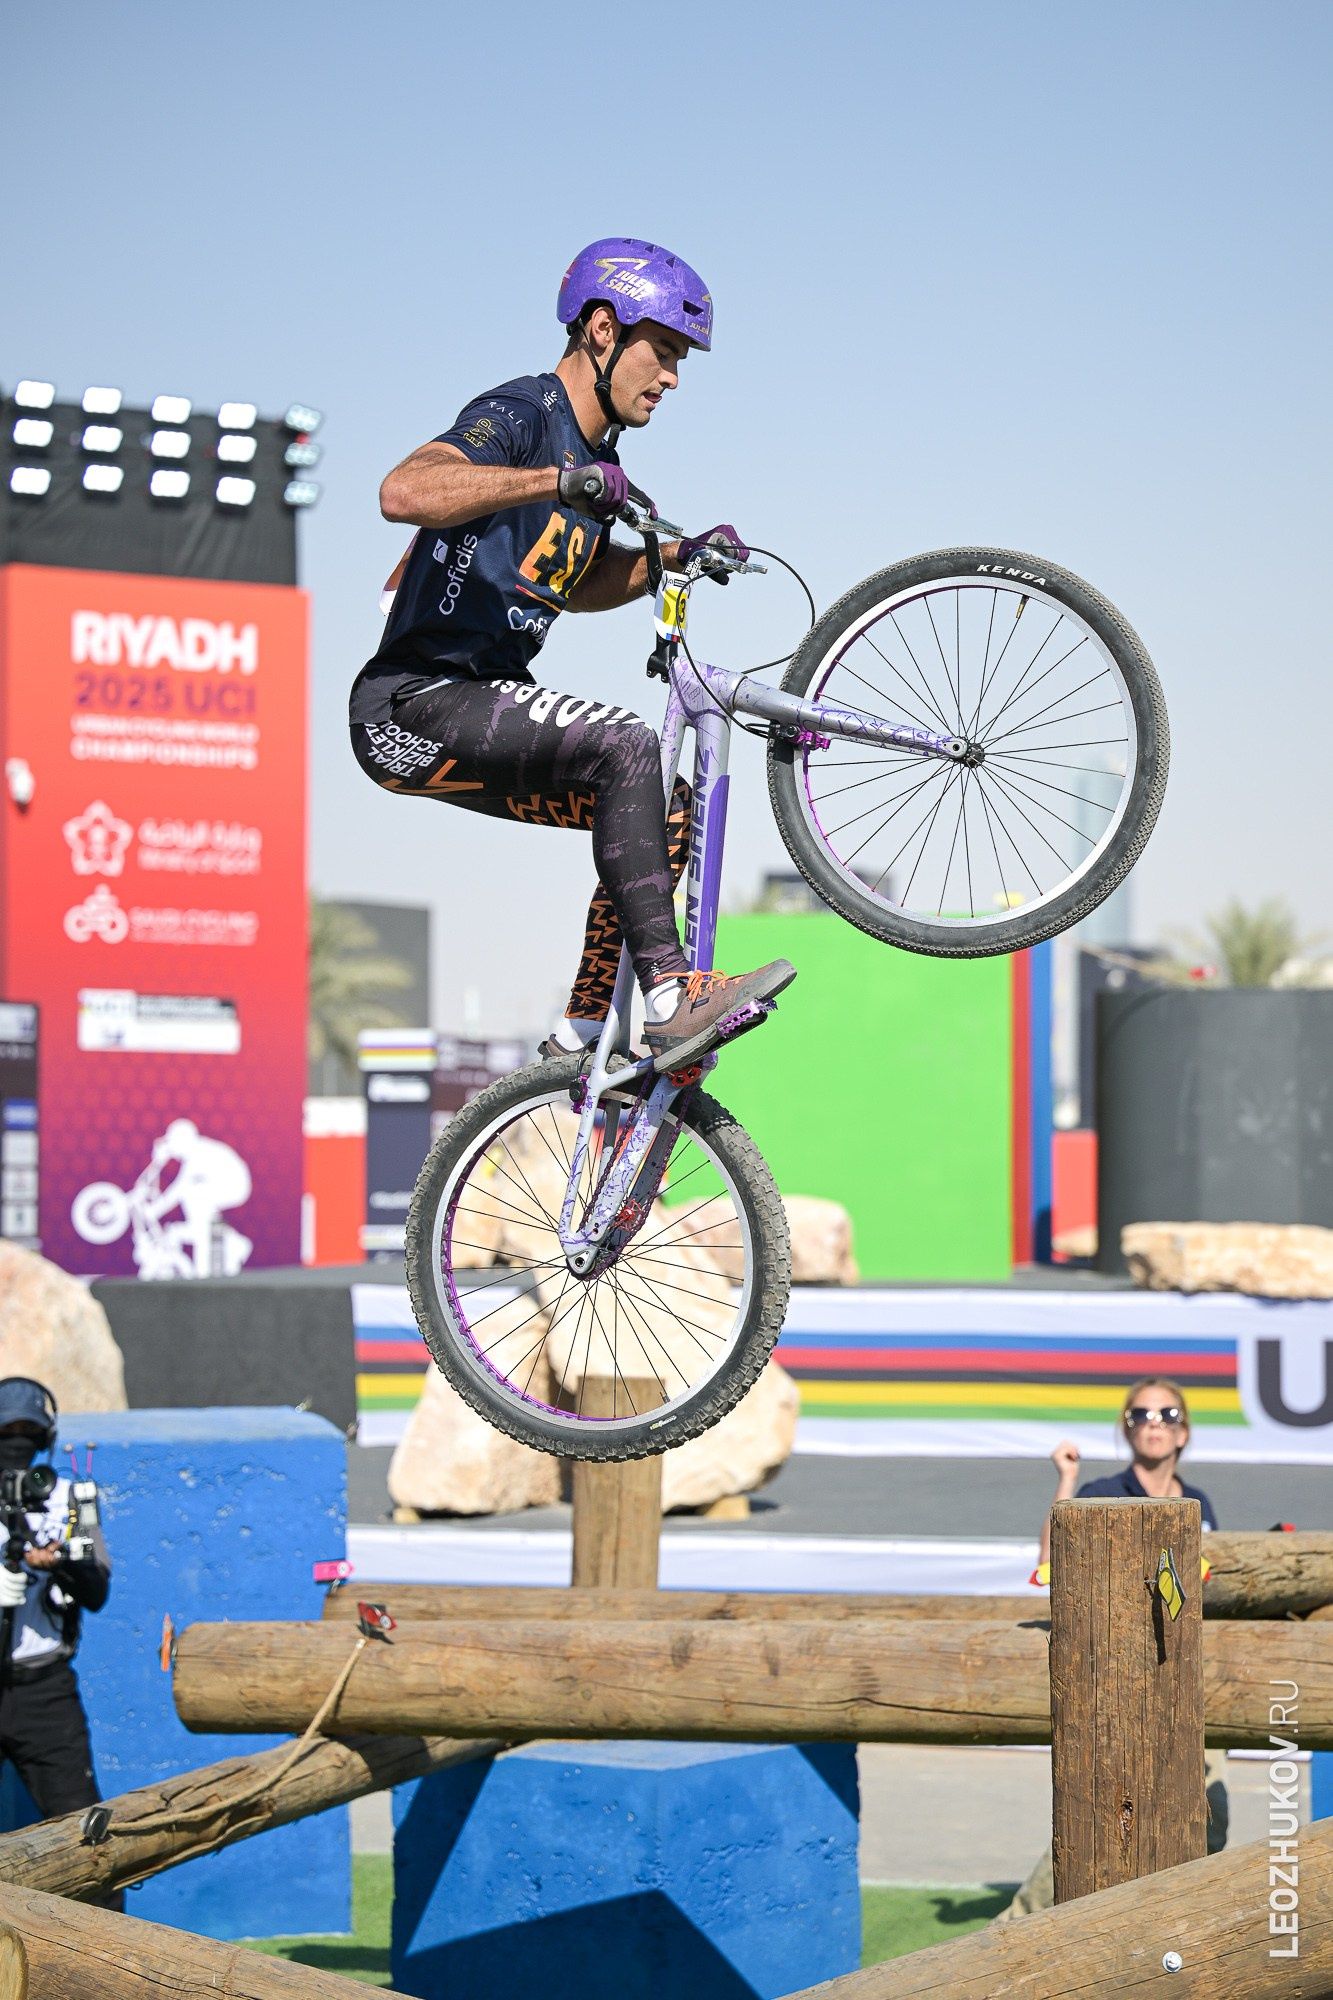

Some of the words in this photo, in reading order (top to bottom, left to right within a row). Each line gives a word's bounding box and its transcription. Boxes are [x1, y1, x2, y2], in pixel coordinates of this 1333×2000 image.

[518, 511, 589, 599] ES
[976, 564, 1047, 586] KENDA
[71, 609, 259, 676] RIYADH
[75, 670, 173, 712] 2025
[184, 679, 258, 718] UCI
